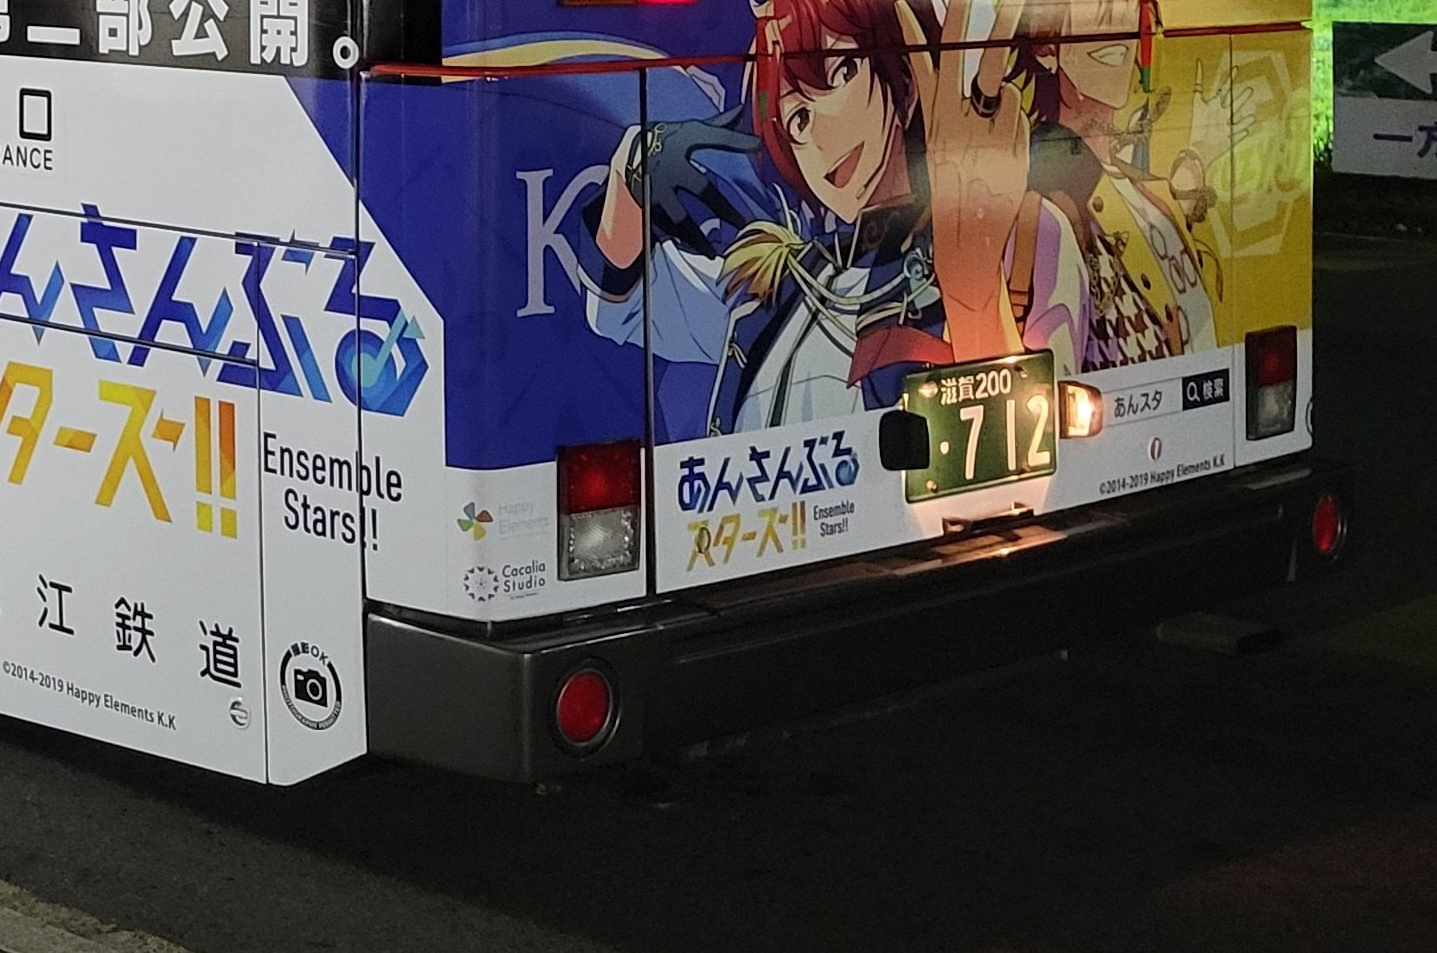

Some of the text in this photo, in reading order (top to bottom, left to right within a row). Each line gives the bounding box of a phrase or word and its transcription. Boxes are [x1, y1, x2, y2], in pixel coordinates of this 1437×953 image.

[1202, 378, 1224, 400] 検索
[1114, 389, 1163, 418] あんスタ
[263, 431, 404, 503] Ensemble
[677, 430, 860, 514] あんさんぶる
[1150, 468, 1176, 485] Happy
[1177, 459, 1211, 478] Elements
[283, 487, 380, 552] Stars!!
[813, 499, 855, 522] Ensemble
[820, 517, 850, 537] Stars!!
[502, 559, 546, 578] Cacalia
[503, 575, 546, 593] Studio
[66, 681, 102, 709] Happy
[103, 693, 155, 724] Elements
[157, 711, 177, 731] K.K
